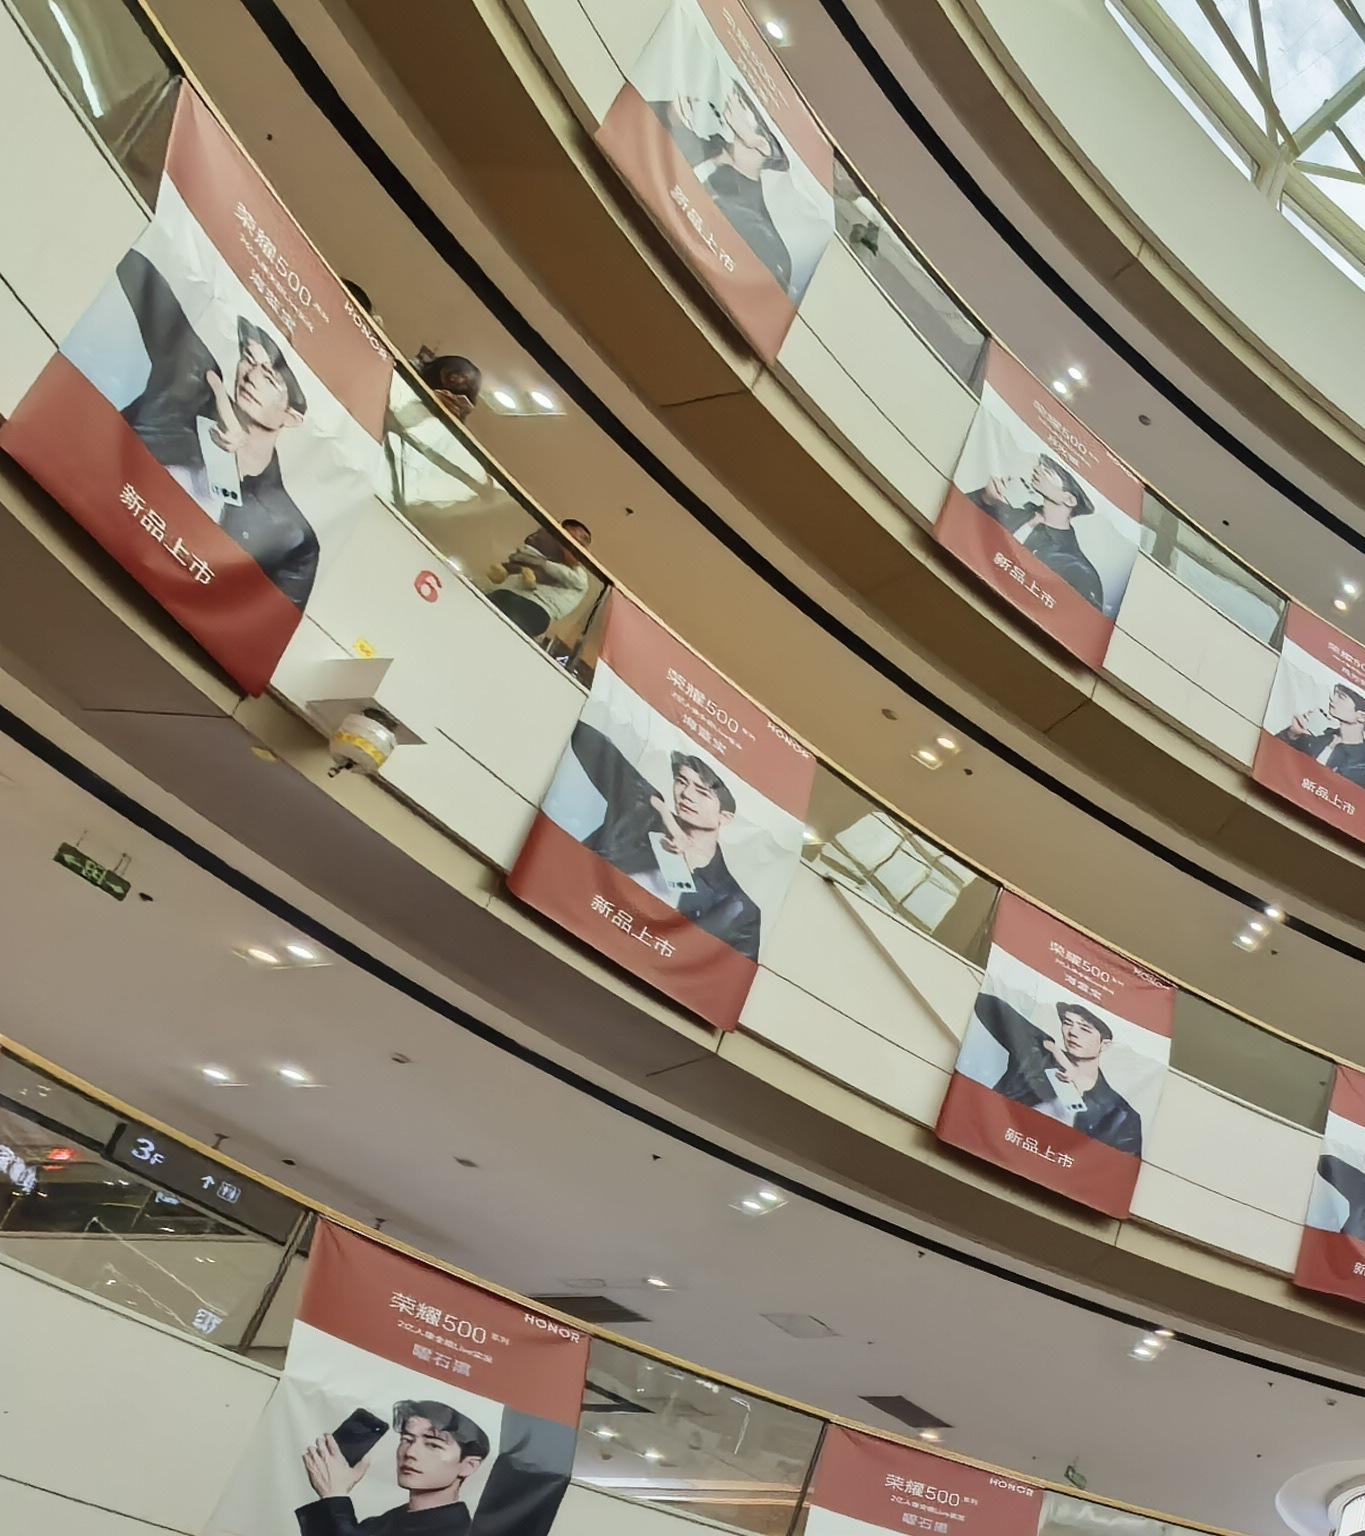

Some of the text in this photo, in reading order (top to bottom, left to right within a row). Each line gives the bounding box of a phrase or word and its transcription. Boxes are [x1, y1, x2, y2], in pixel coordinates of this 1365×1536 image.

[119, 482, 216, 586] 新品上市
[414, 571, 442, 603] 6
[994, 552, 1057, 609] 新品上市
[1301, 778, 1356, 816] 新品上市
[592, 895, 676, 958] 新品上市
[131, 1138, 165, 1165] 3F
[1004, 1127, 1075, 1169] 新品上市
[389, 1291, 487, 1344] 荣耀500
[523, 1312, 581, 1344] HONOR
[885, 1473, 960, 1507] 荣耀500
[989, 1477, 1034, 1497] HONOR
